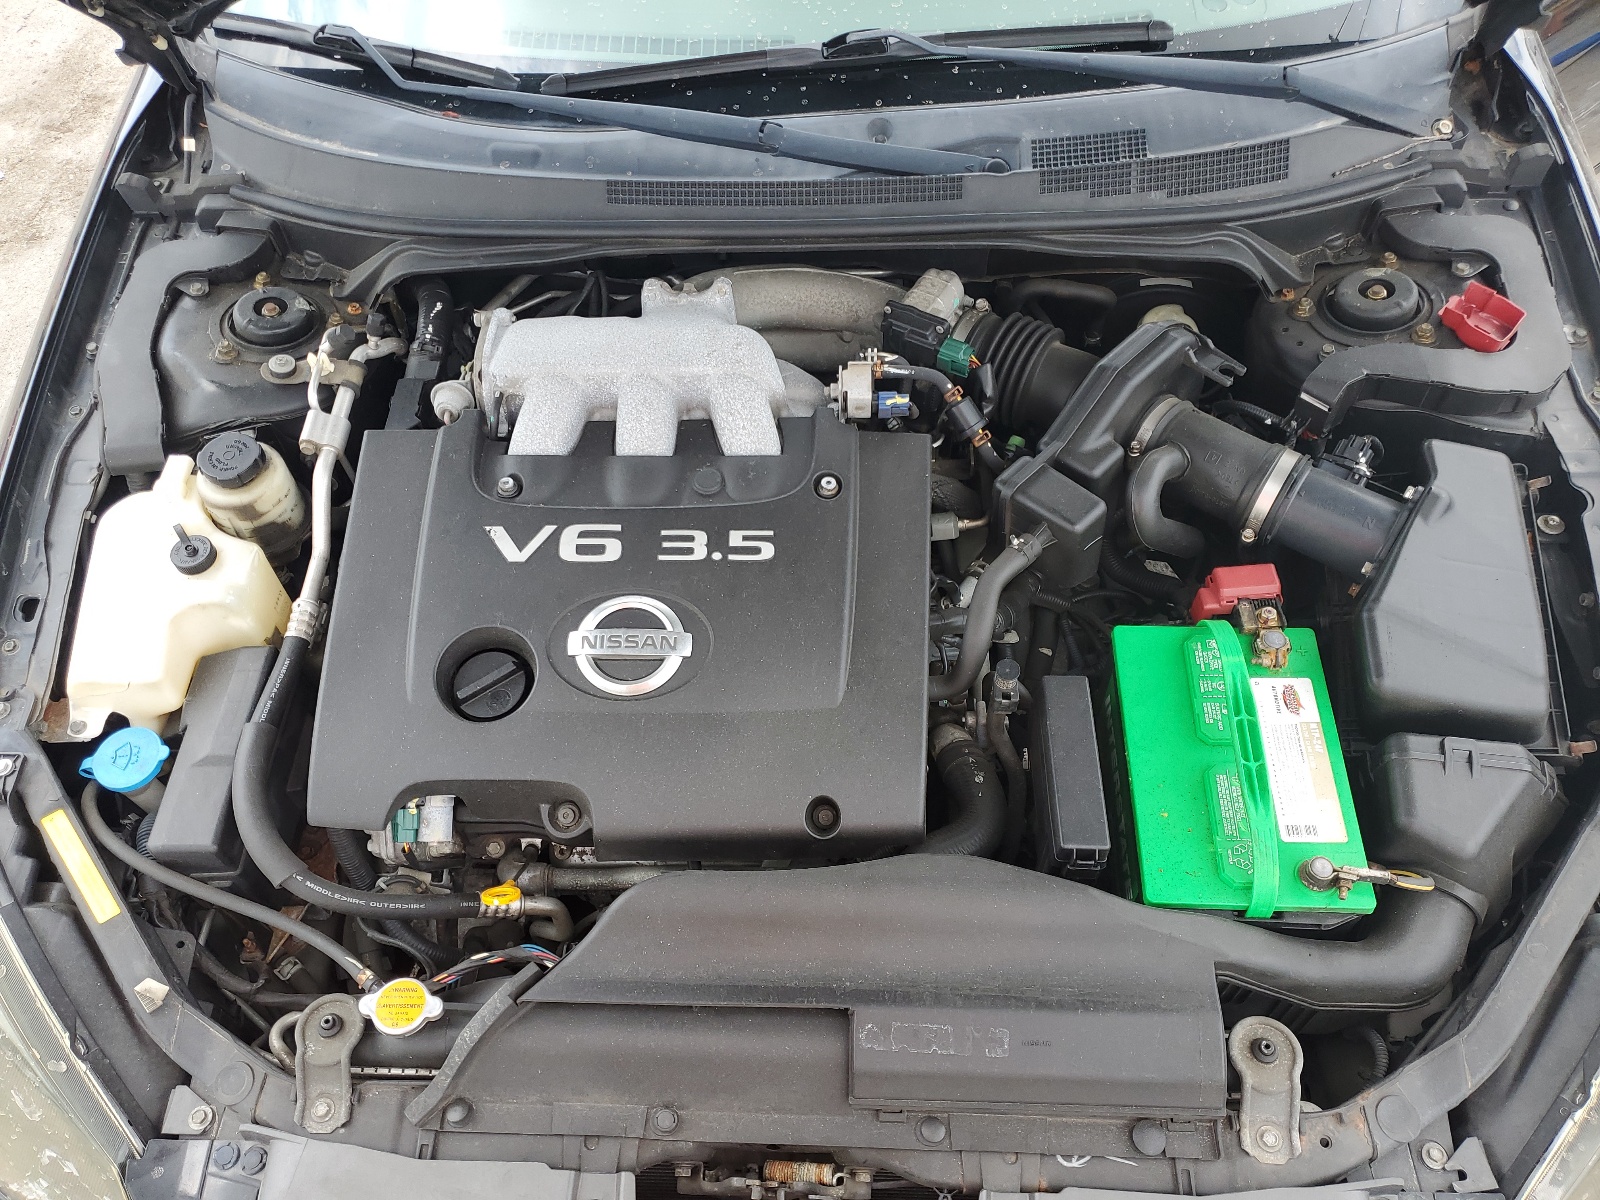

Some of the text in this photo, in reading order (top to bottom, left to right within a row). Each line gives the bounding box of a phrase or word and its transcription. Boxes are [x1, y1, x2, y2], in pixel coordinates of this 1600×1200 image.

[482, 523, 776, 563] V6 3.5
[581, 634, 678, 650] NISSAN
